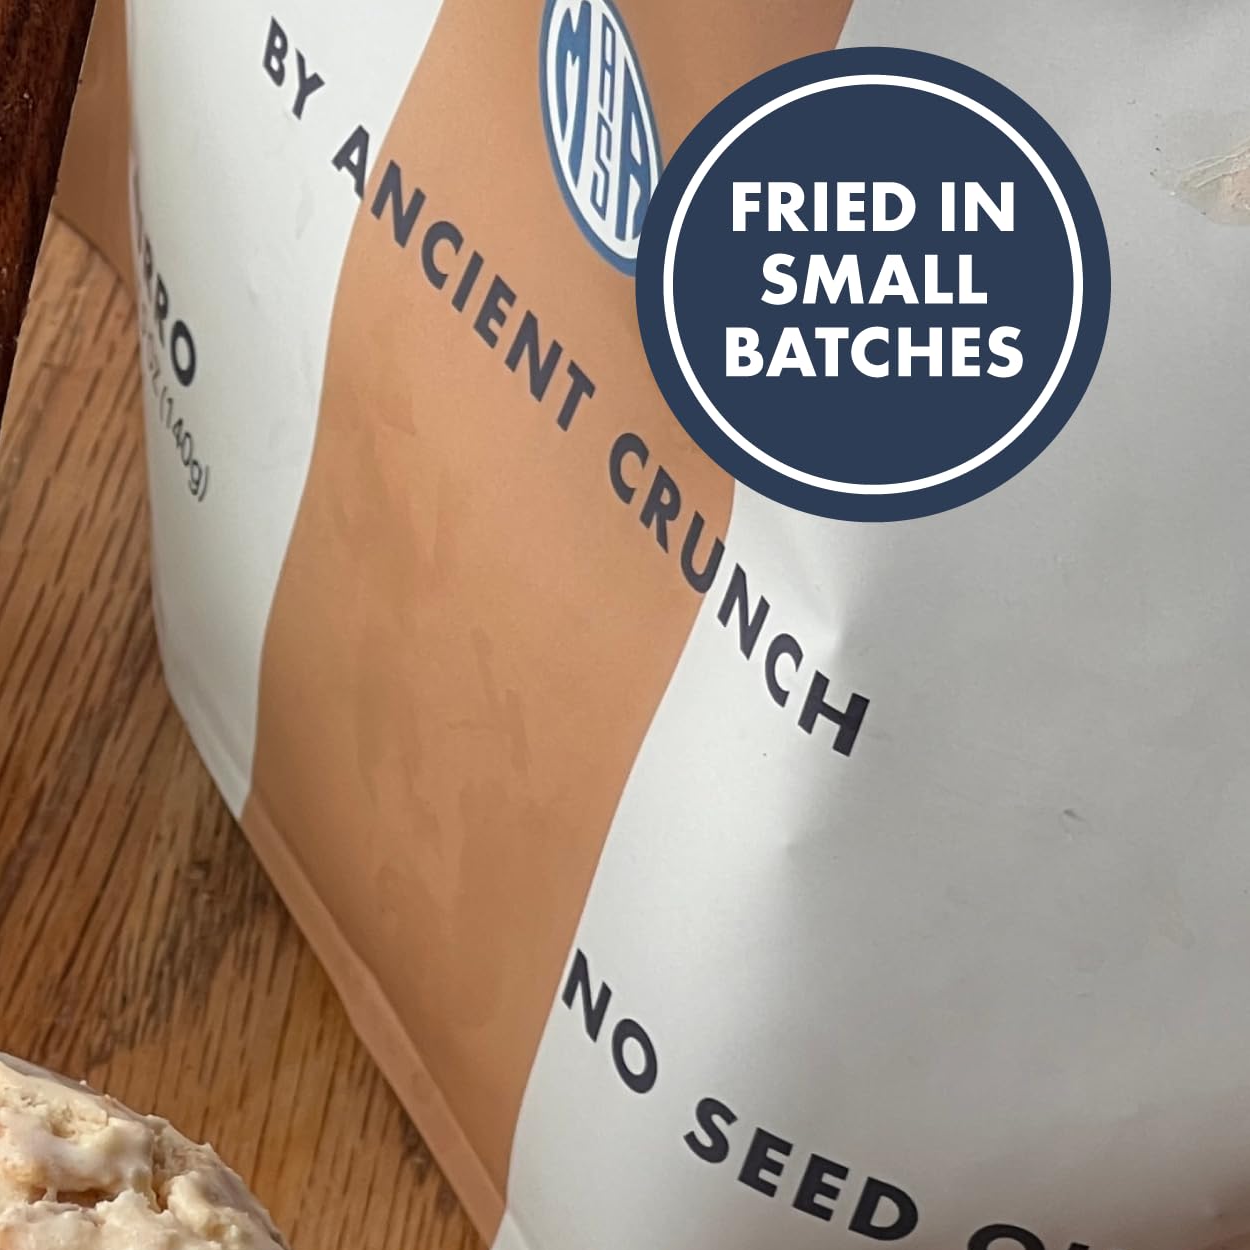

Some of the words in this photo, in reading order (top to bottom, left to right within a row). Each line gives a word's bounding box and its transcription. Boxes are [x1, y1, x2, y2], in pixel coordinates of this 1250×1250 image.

[263, 16, 325, 120] BY
[331, 125, 596, 432] ANCIENT
[609, 432, 870, 757] CRUNCH
[562, 948, 658, 1094] NO
[683, 1097, 919, 1241] SEED
